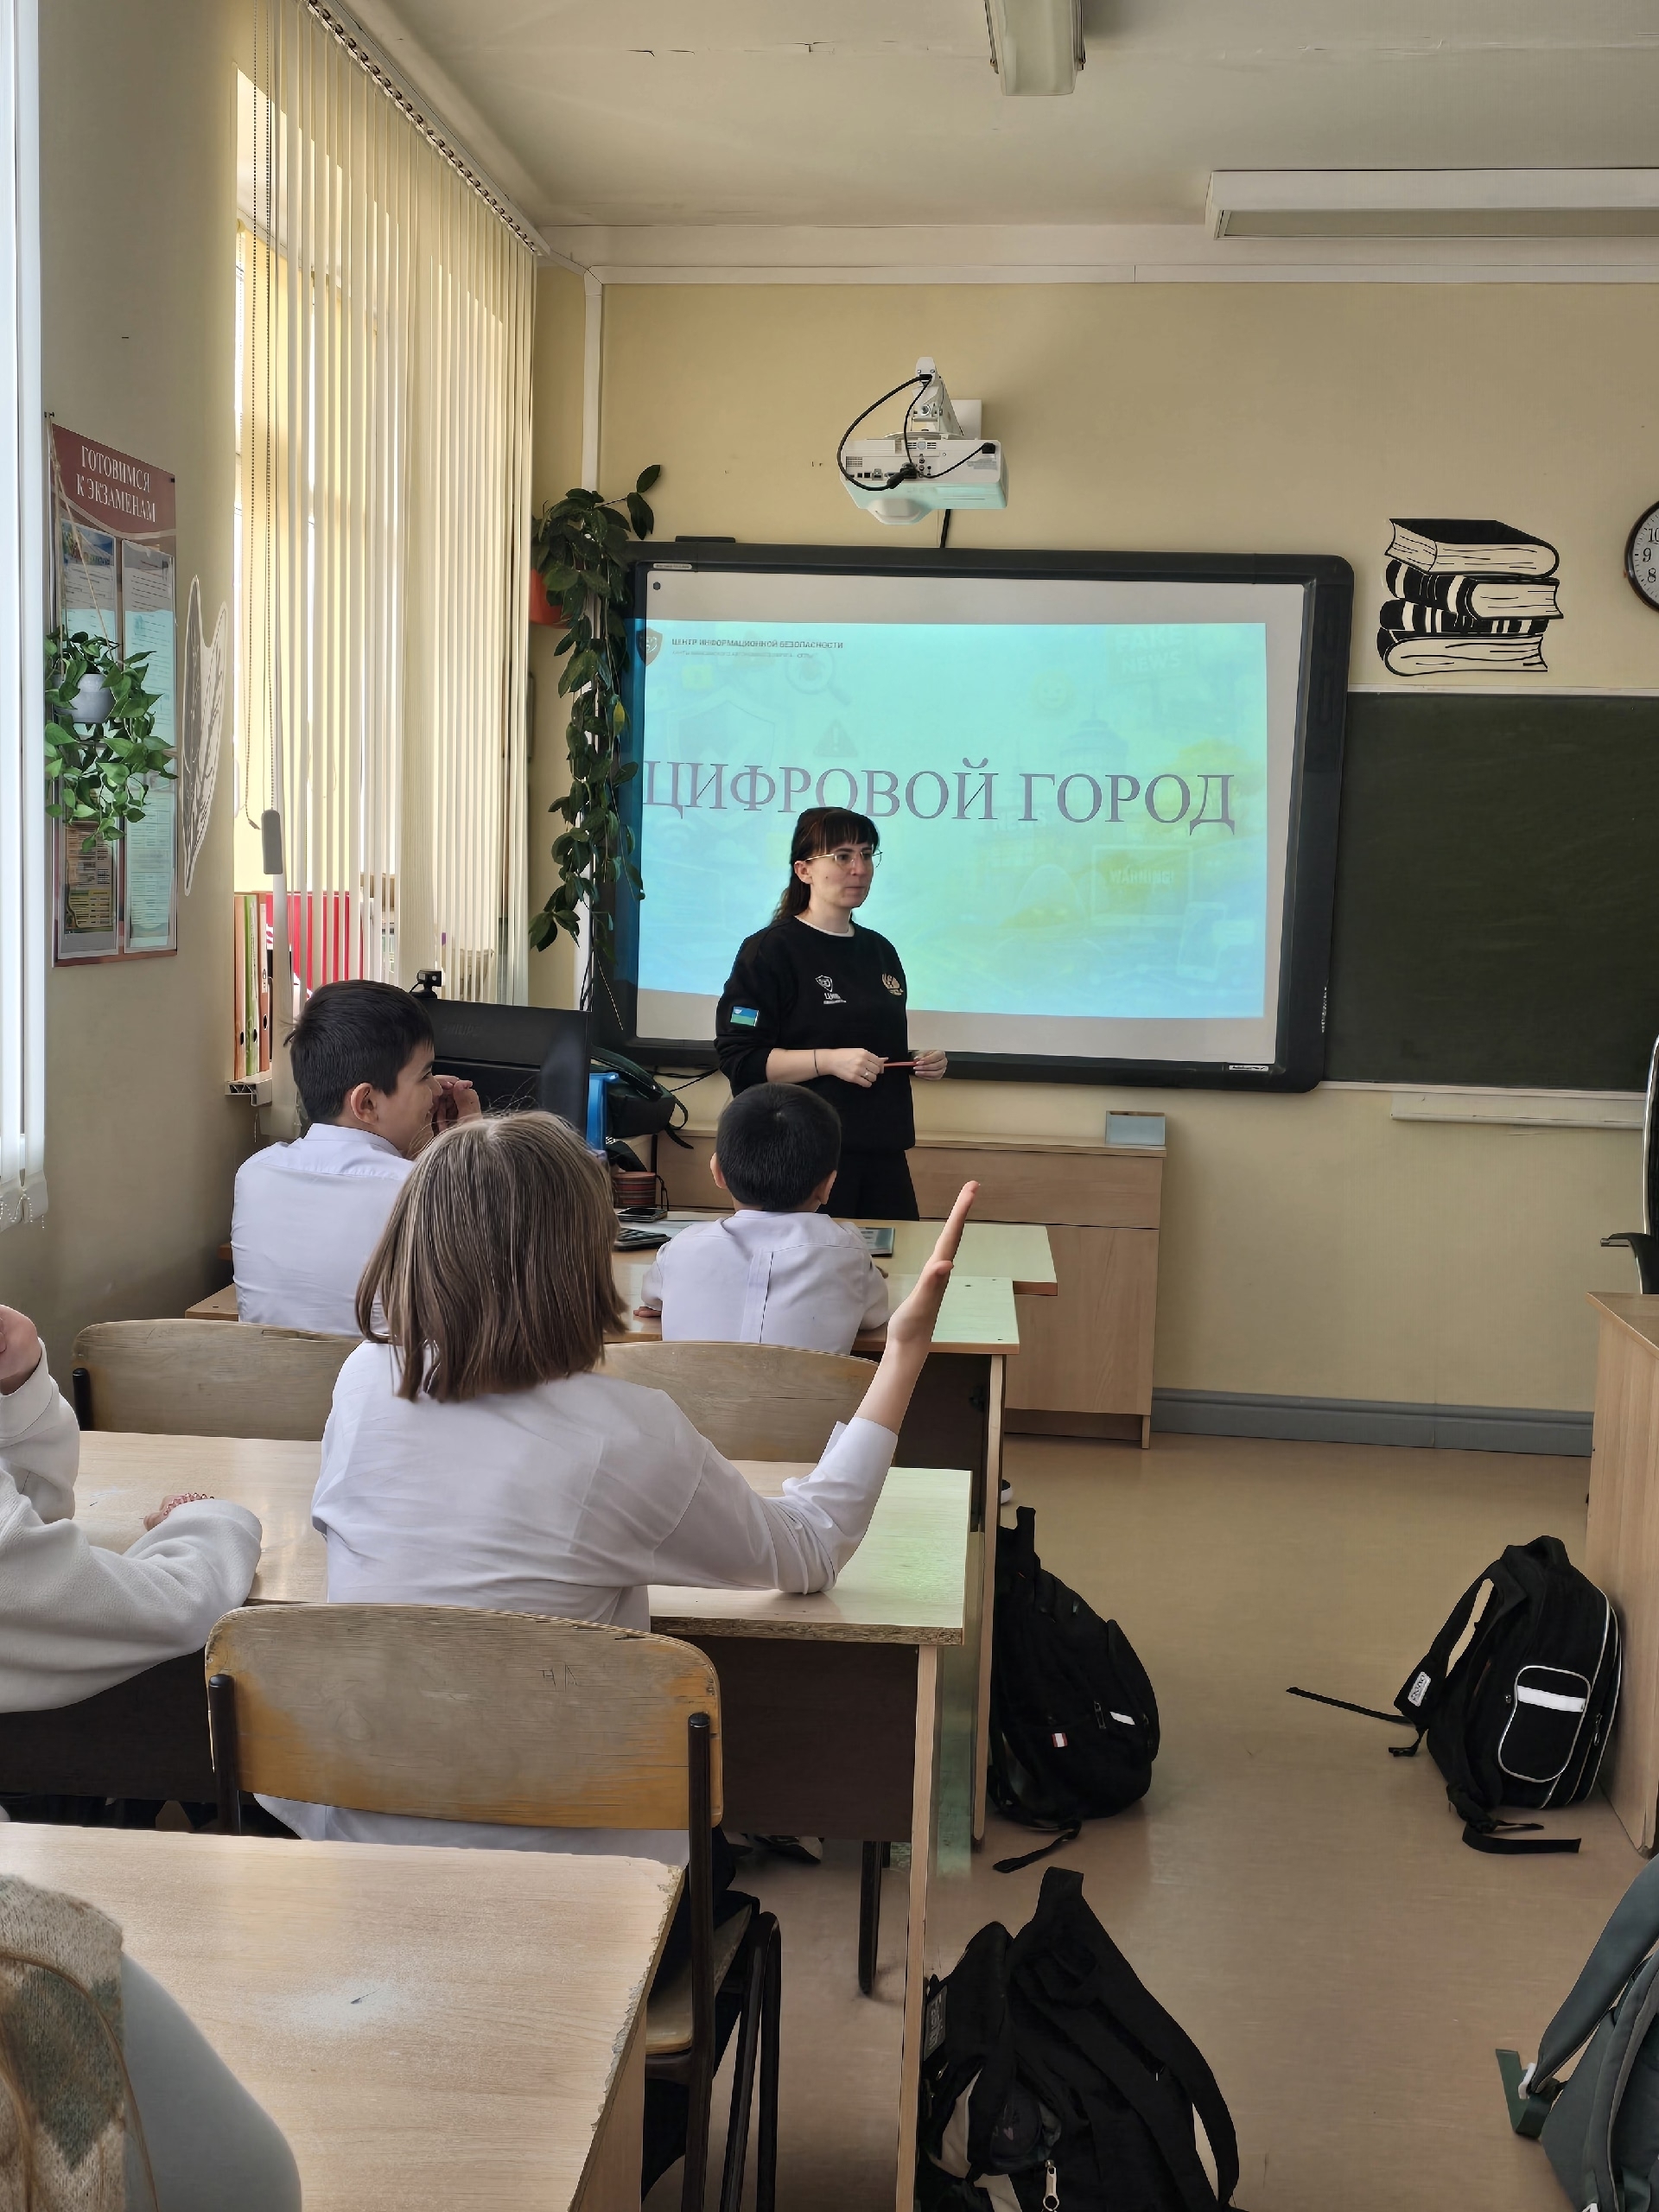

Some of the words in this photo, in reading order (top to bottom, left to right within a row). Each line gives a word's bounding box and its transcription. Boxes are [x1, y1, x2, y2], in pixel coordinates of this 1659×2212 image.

[81, 445, 150, 493] ГОТОВИМСЯ
[76, 473, 85, 497] К
[86, 478, 156, 523] ЭКЗАМЕНАМ
[1643, 548, 1652, 563] 9
[1648, 568, 1656, 582] 8
[699, 639, 778, 648] ИНФОРМАЦИОННОЙ
[1122, 651, 1181, 674] NEWS
[643, 757, 999, 820] ЦИФРОВОЙ
[1018, 772, 1235, 836] ГОРОД
